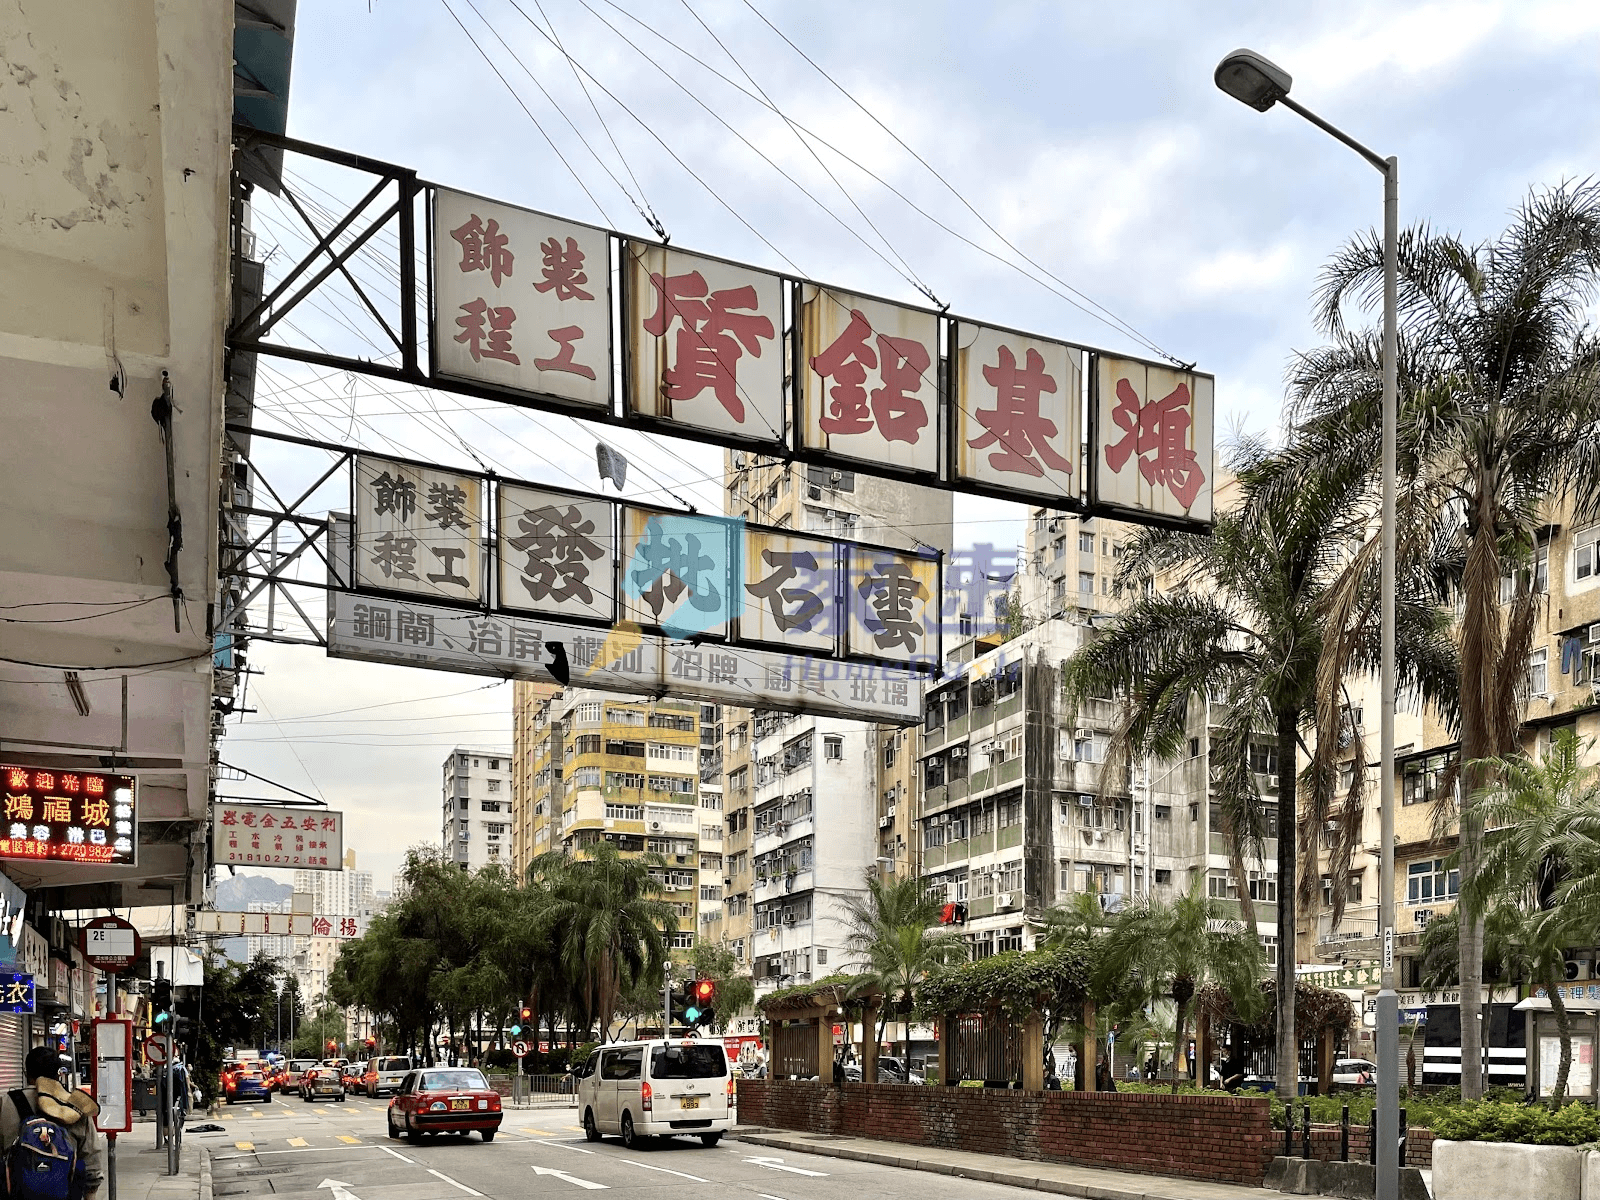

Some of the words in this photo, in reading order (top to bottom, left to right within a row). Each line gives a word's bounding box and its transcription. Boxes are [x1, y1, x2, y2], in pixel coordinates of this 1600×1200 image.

[9, 770, 104, 792] 歡迎光臨
[4, 793, 110, 826] 鴻福城
[229, 852, 300, 864] 31810272
[93, 930, 105, 941] 2E
[1385, 930, 1392, 942] AF
[0, 981, 29, 1004] 衣
